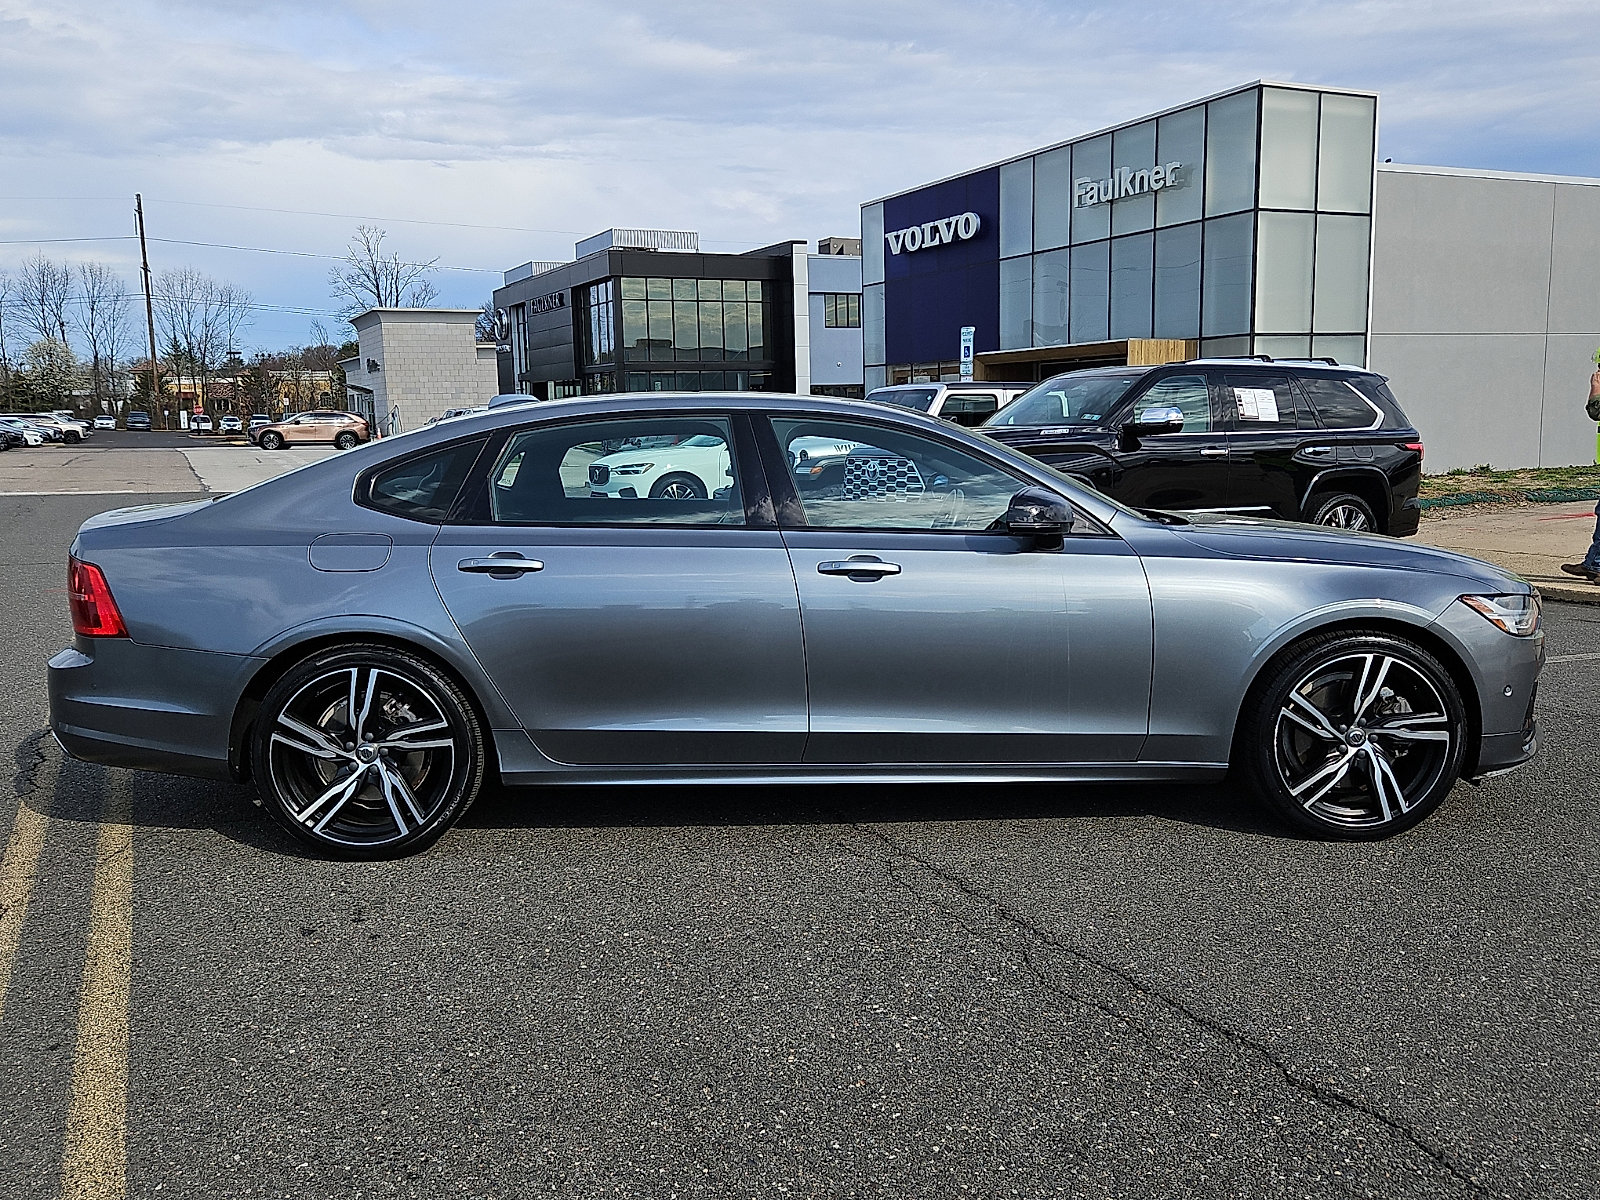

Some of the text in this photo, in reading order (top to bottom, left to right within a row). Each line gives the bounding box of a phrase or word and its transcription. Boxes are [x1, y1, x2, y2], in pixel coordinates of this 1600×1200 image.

[1074, 161, 1182, 208] Faulkner
[885, 212, 980, 255] VOLVO
[530, 292, 563, 315] FAULKNER
